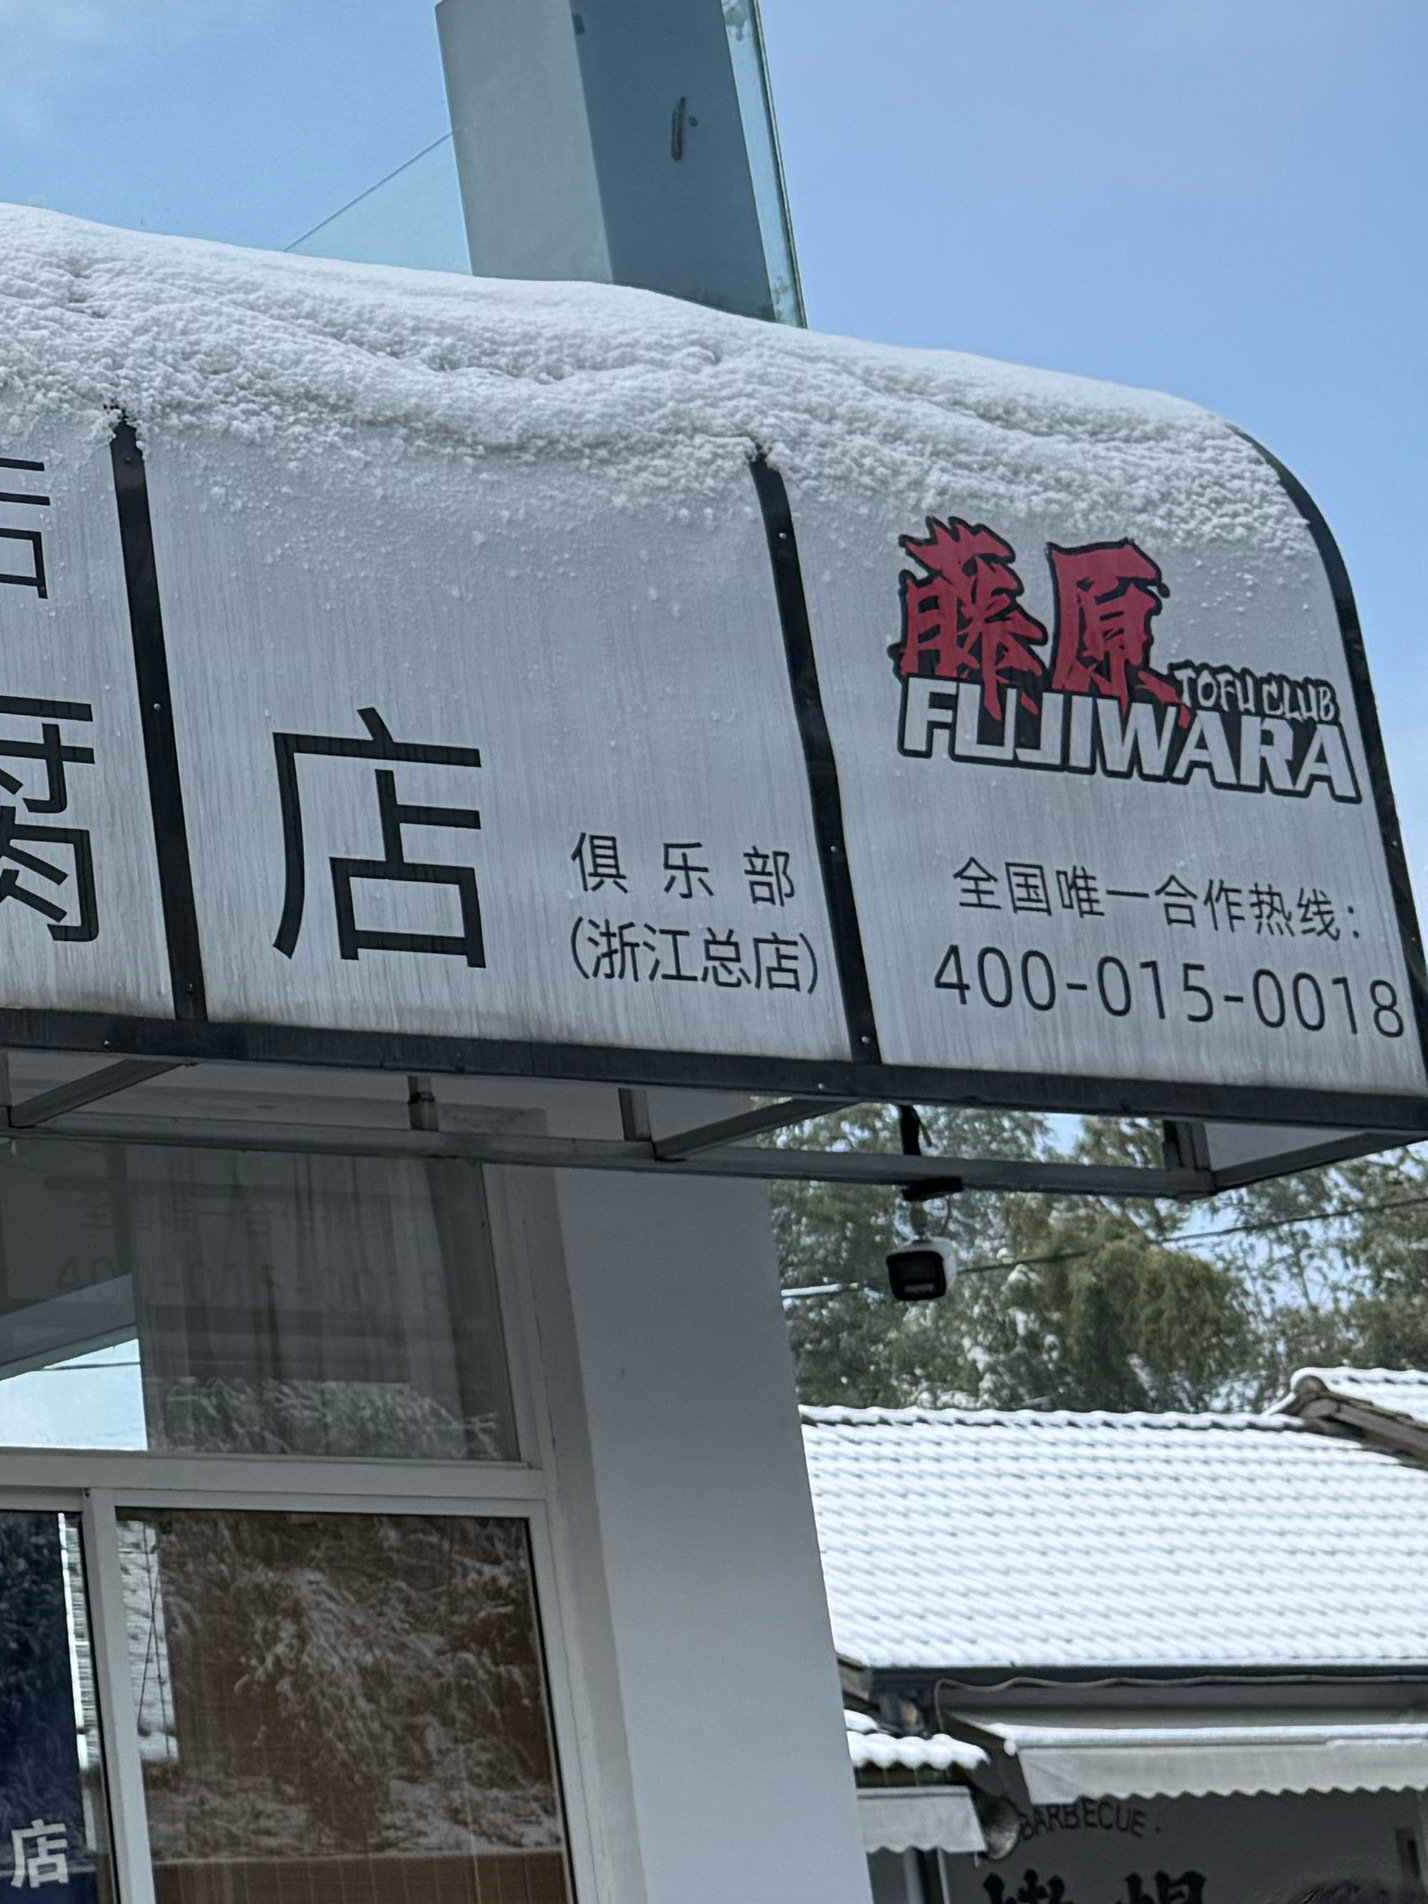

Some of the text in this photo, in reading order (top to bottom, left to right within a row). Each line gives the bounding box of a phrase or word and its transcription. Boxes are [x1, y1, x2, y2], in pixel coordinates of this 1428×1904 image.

[1168, 663, 1340, 722] TOFU CLUB
[898, 675, 1363, 805] FUJIWARA
[571, 831, 795, 908] 俱乐部
[952, 856, 1362, 943] 全国唯一合作热线:
[571, 915, 818, 995] (浙江总店)
[934, 944, 1406, 1040] 400-015-0018
